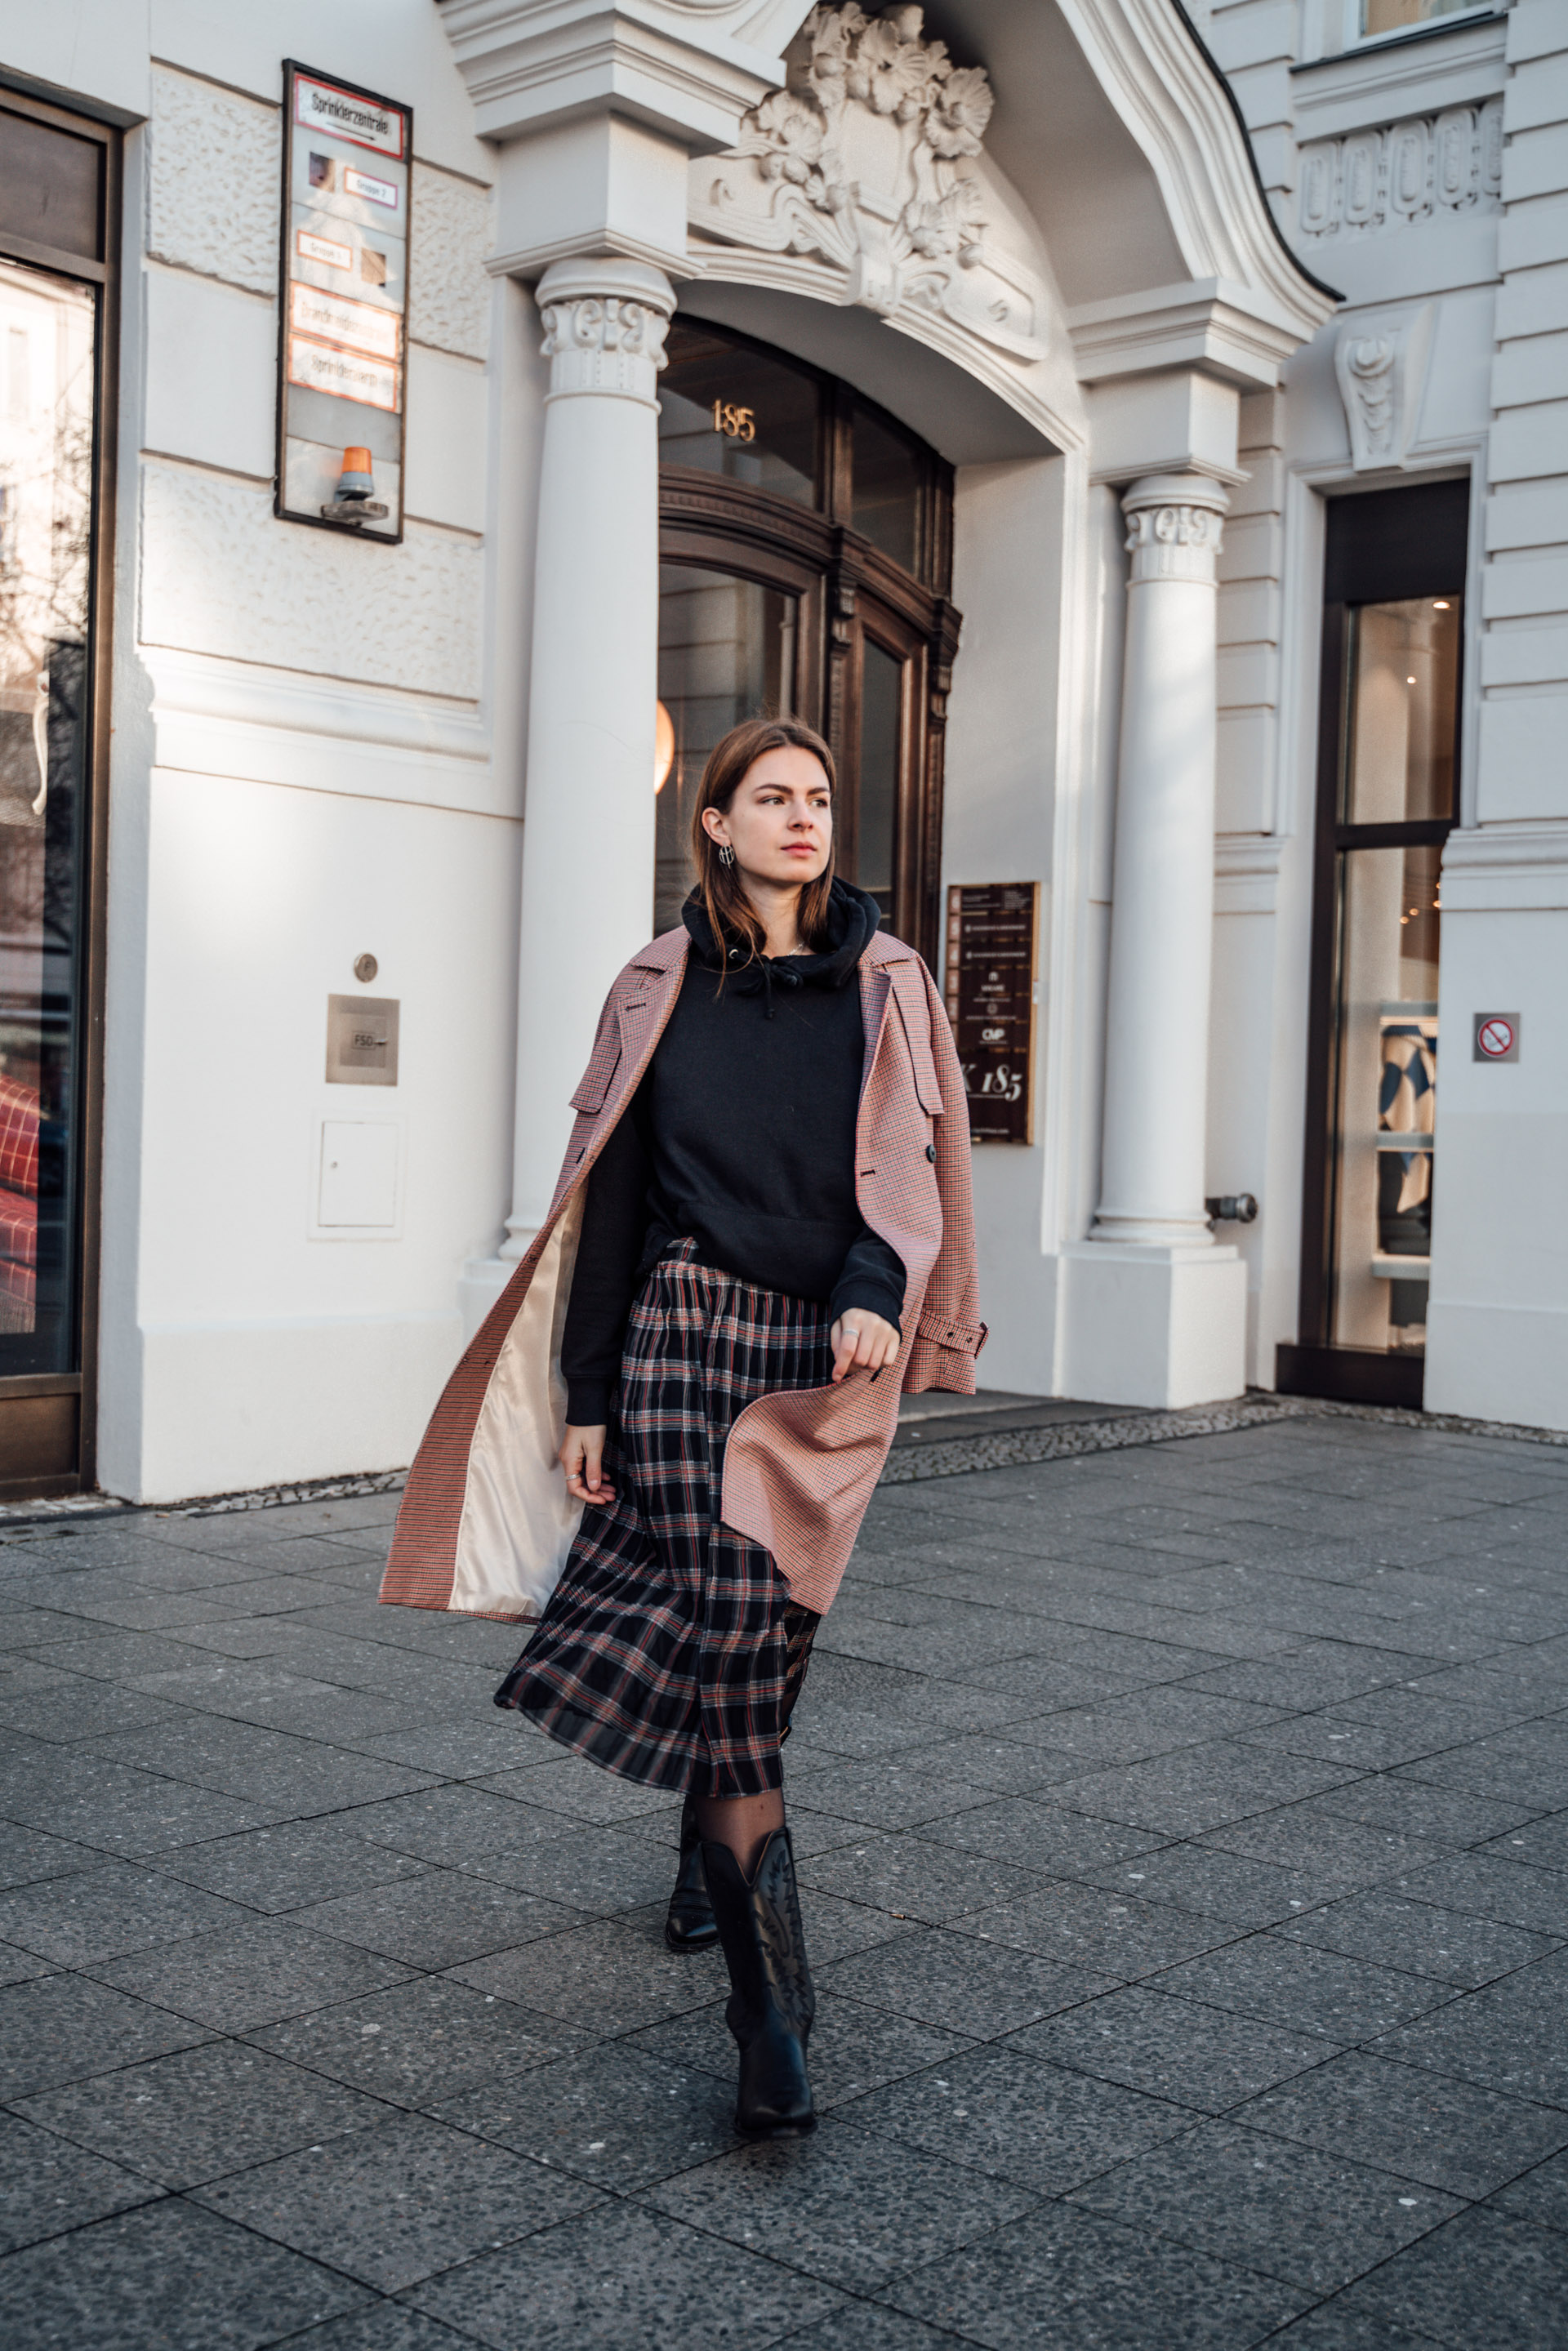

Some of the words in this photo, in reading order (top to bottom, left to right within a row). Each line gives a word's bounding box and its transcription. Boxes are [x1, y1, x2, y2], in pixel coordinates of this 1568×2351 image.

[311, 93, 389, 135] Sprinklerzentrale
[356, 179, 380, 196] Gruppe
[381, 189, 387, 198] 2
[310, 354, 378, 387] Sprinkleralarm
[711, 399, 756, 442] 185
[354, 1034, 374, 1047] FSD
[981, 1064, 1022, 1102] 185
